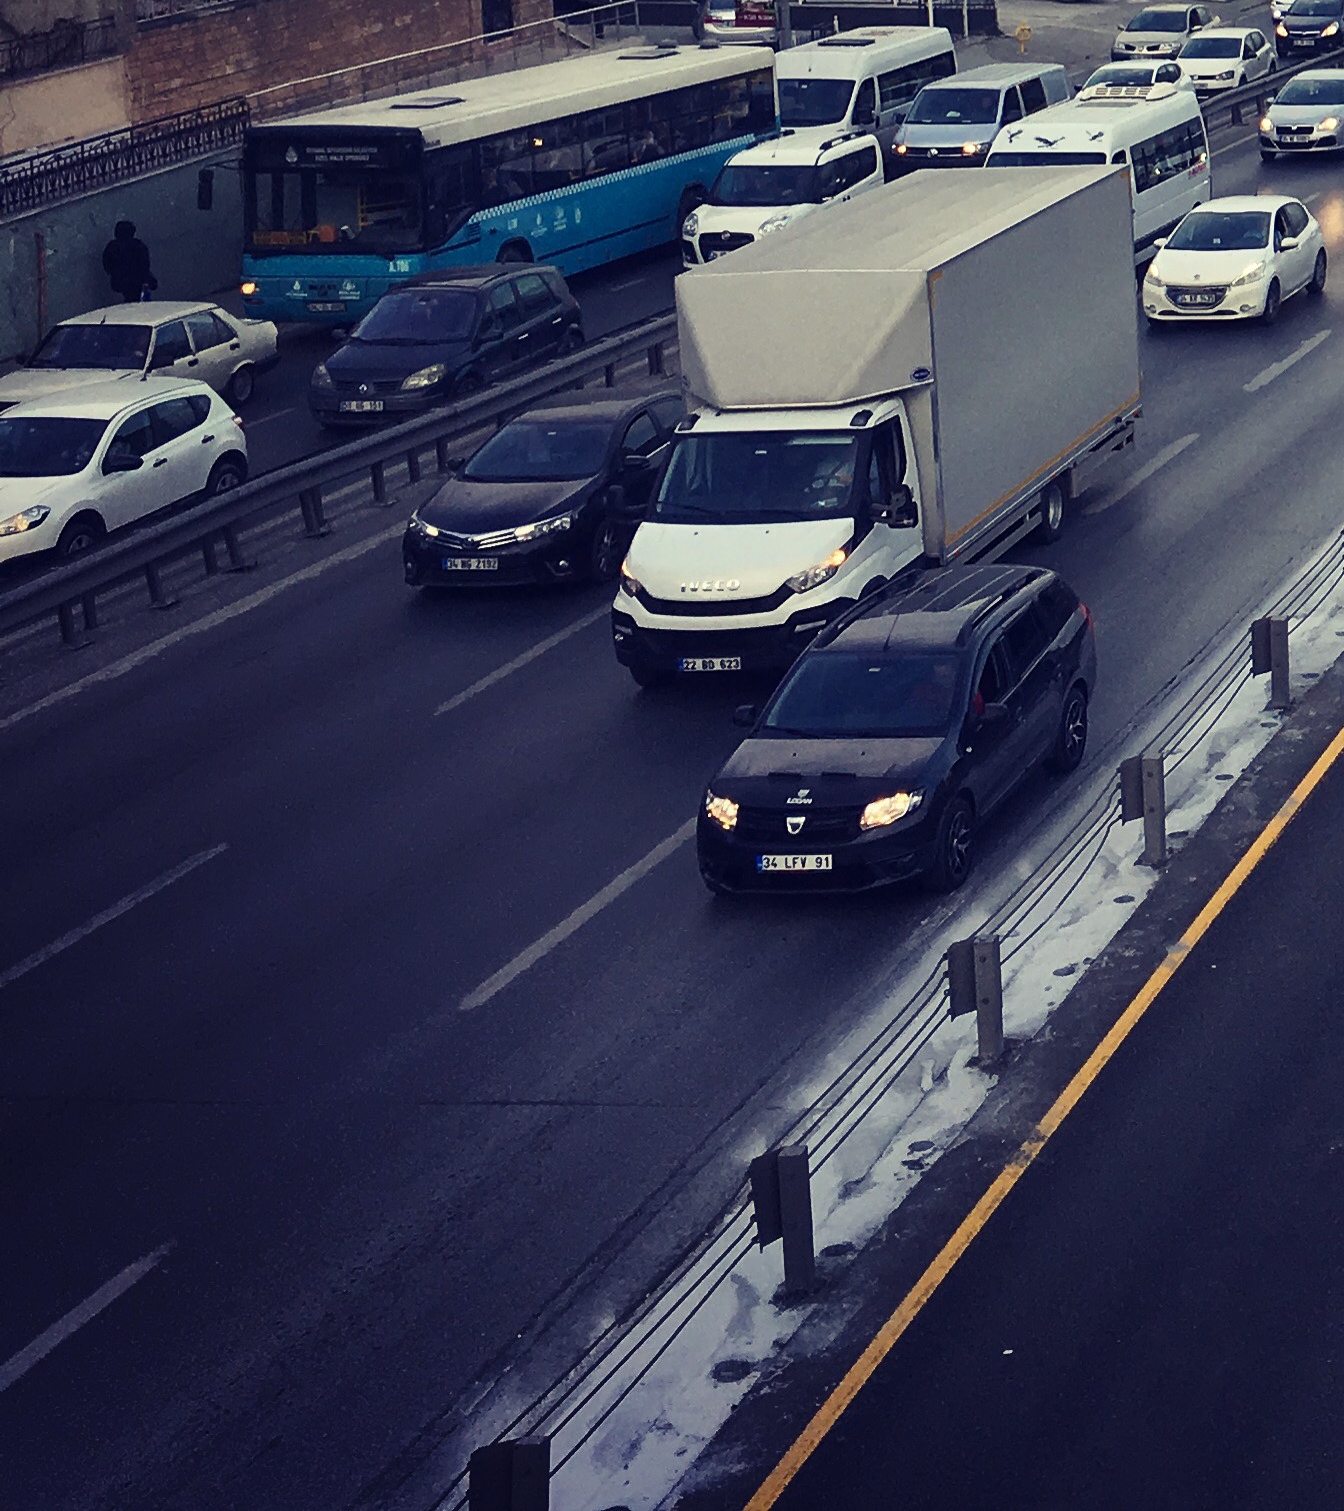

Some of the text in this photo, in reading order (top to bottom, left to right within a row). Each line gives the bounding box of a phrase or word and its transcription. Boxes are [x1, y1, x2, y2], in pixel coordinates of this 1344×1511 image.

[447, 558, 459, 569] 34
[680, 578, 741, 593] IVECO
[684, 660, 697, 670] 22
[720, 658, 740, 670] 623
[763, 855, 830, 869] 34 LFV 91
